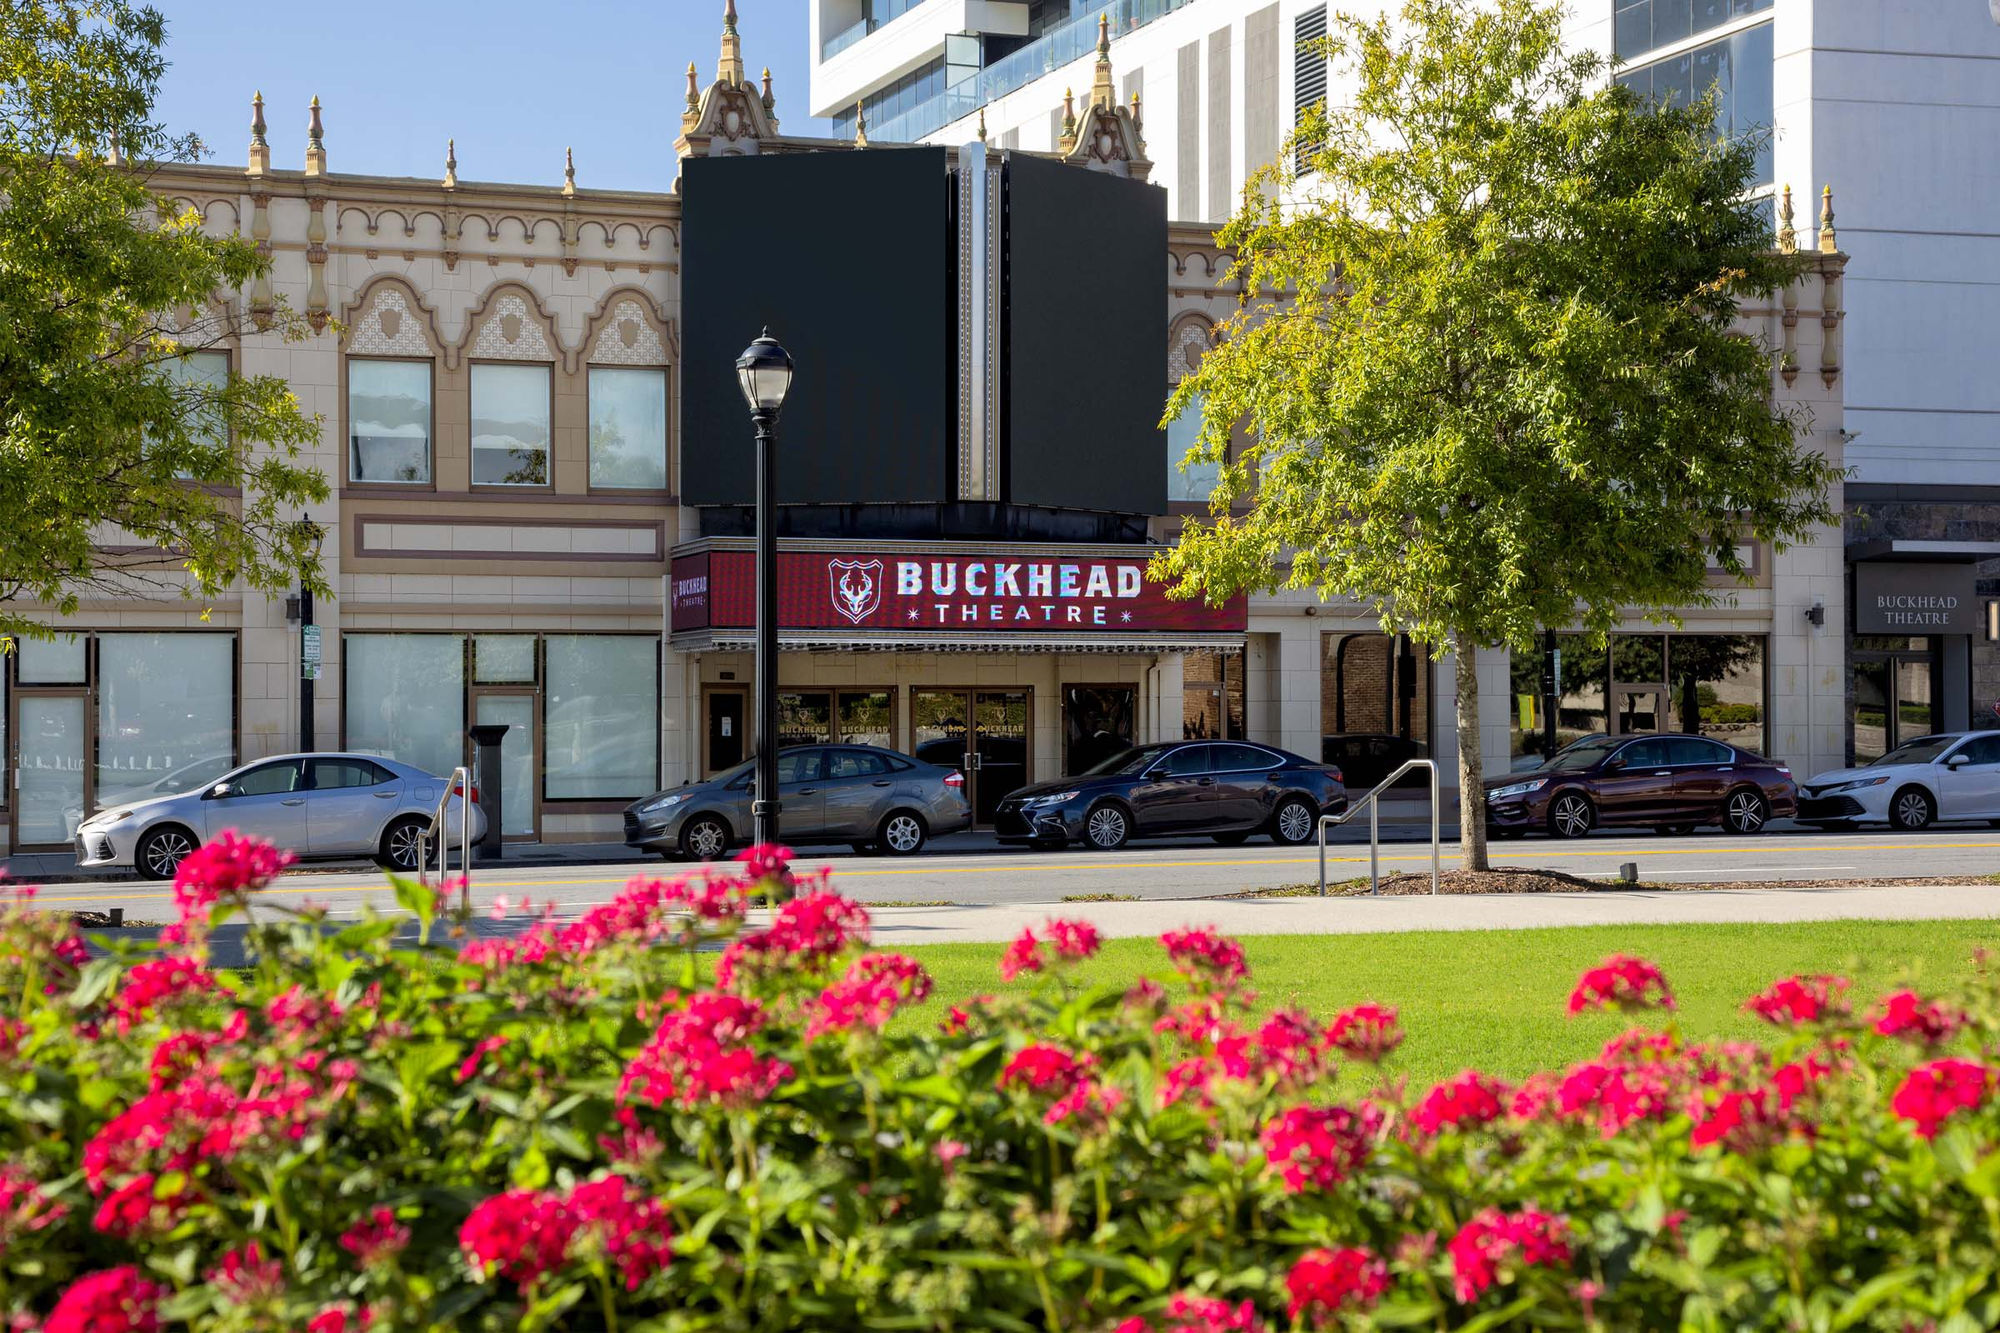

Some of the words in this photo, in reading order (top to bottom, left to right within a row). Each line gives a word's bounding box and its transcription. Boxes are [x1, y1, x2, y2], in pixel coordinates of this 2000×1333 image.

[897, 562, 1141, 597] BUCKHEAD
[1878, 595, 1957, 608] BUCKHEAD
[935, 604, 1106, 624] THEATRE
[1884, 611, 1949, 624] THEATRE
